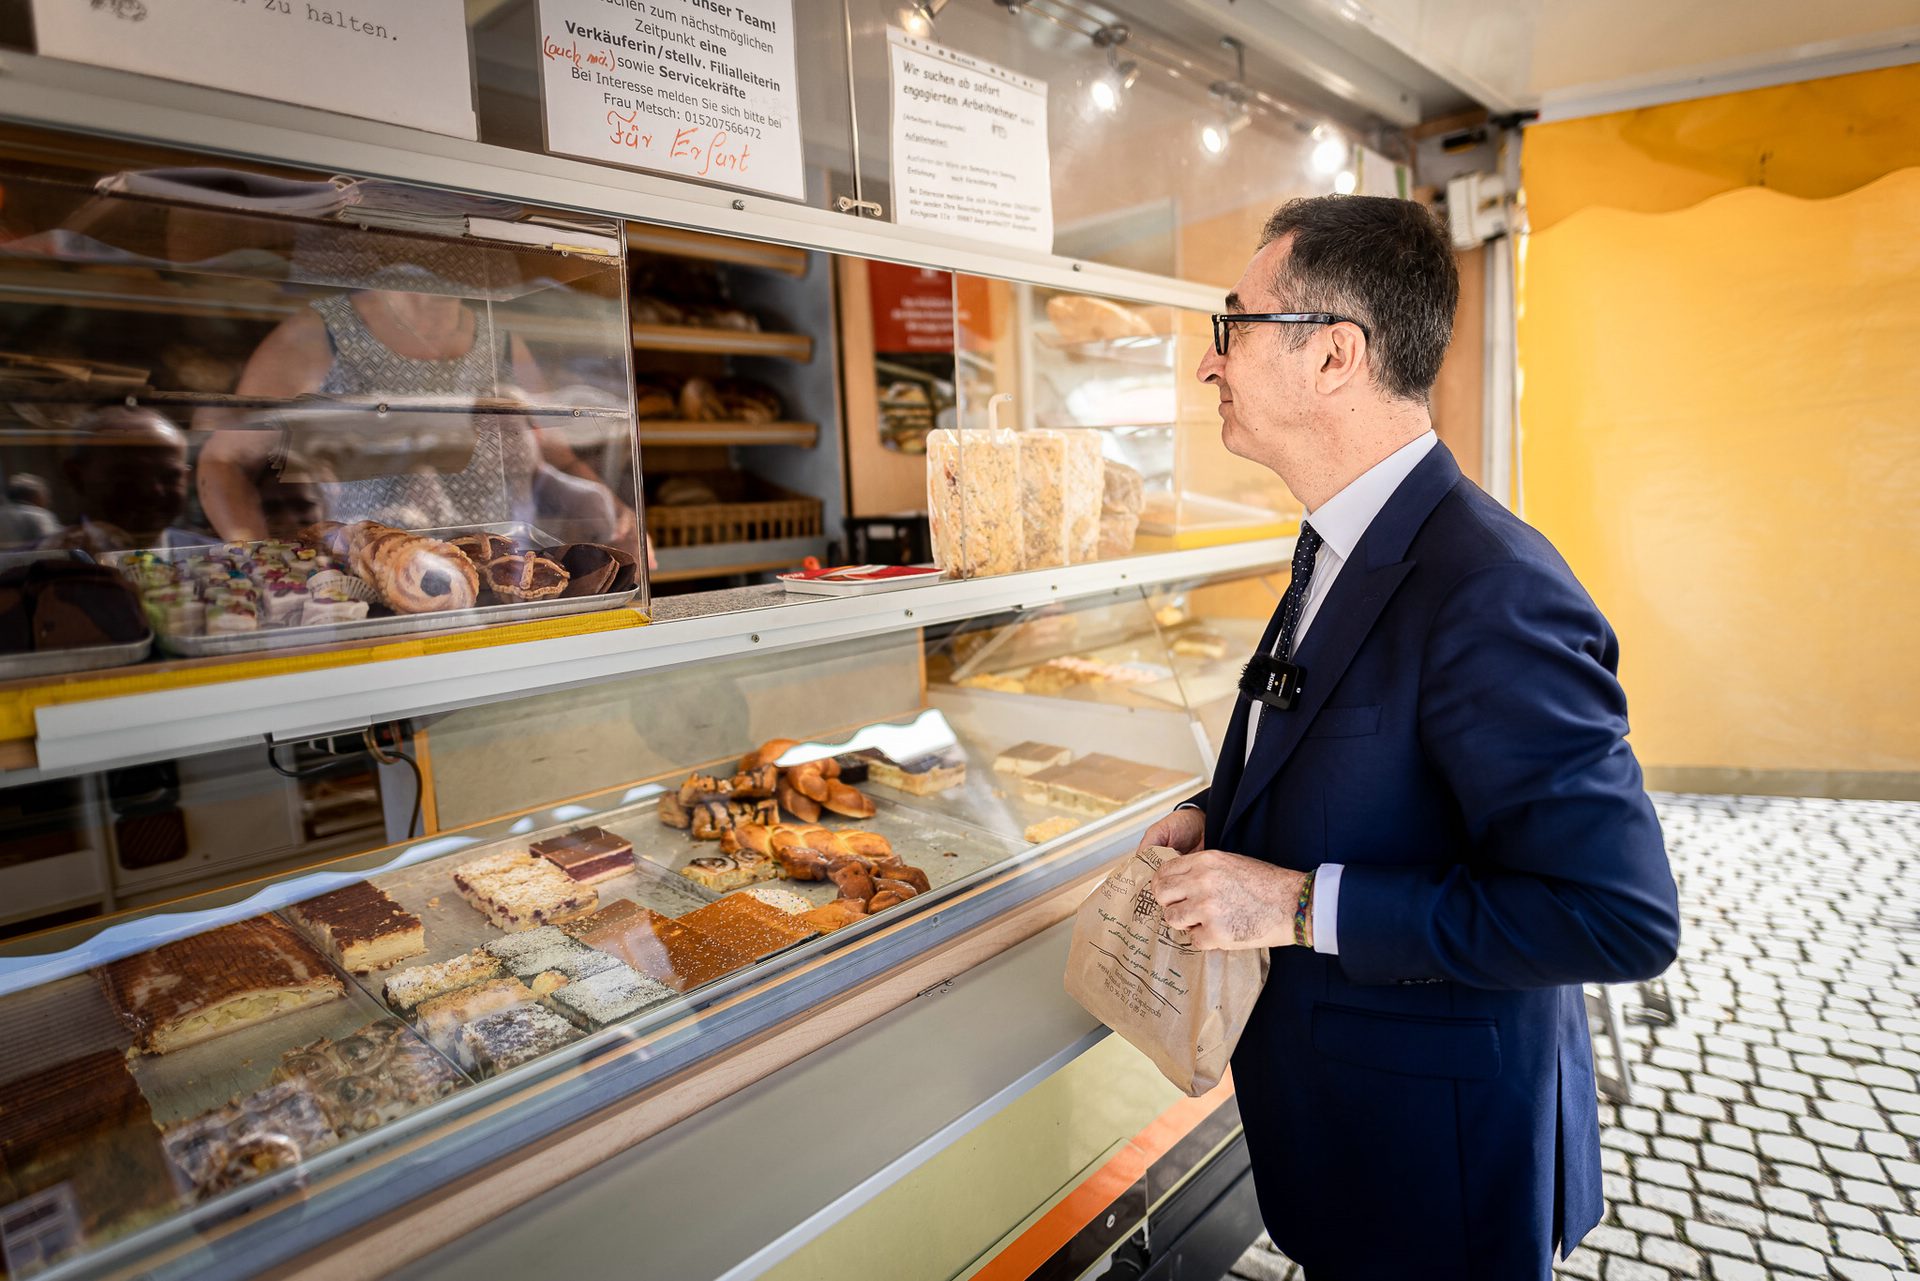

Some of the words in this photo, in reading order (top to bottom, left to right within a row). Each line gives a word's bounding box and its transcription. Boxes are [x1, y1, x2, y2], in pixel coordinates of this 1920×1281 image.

[264, 0, 292, 16] zu
[307, 3, 399, 42] halten.
[602, 0, 646, 13] chen
[649, 5, 678, 22] zum
[681, 15, 774, 54] nächstmöglichen
[634, 18, 696, 48] Zeitpunkt
[699, 39, 727, 57] eine
[692, 0, 732, 17] unser
[735, 7, 777, 34] Team!
[543, 35, 583, 69] (auch
[564, 19, 706, 69] Verkäuferin/stellv.
[709, 59, 781, 92] Filialleiterin
[571, 66, 592, 82] Bei
[596, 72, 654, 96] Interesse
[657, 88, 699, 107] melden
[701, 97, 718, 112] Sie
[721, 103, 741, 118] sich
[743, 108, 766, 125] bitte
[767, 115, 782, 129] bei
[616, 57, 655, 75] sowie
[659, 65, 746, 100] Servicekräfte
[903, 60, 920, 76] Wir
[922, 70, 956, 87] suchen
[958, 77, 971, 90] ab
[973, 82, 1000, 98] sofort
[603, 92, 632, 109] Frau
[635, 99, 681, 120] Metsch:
[684, 110, 762, 140] 015207566472
[903, 85, 959, 106] engagierten
[961, 98, 1018, 121] Arbeitnehmer
[606, 110, 653, 149] Für
[670, 127, 751, 176] Erfurt
